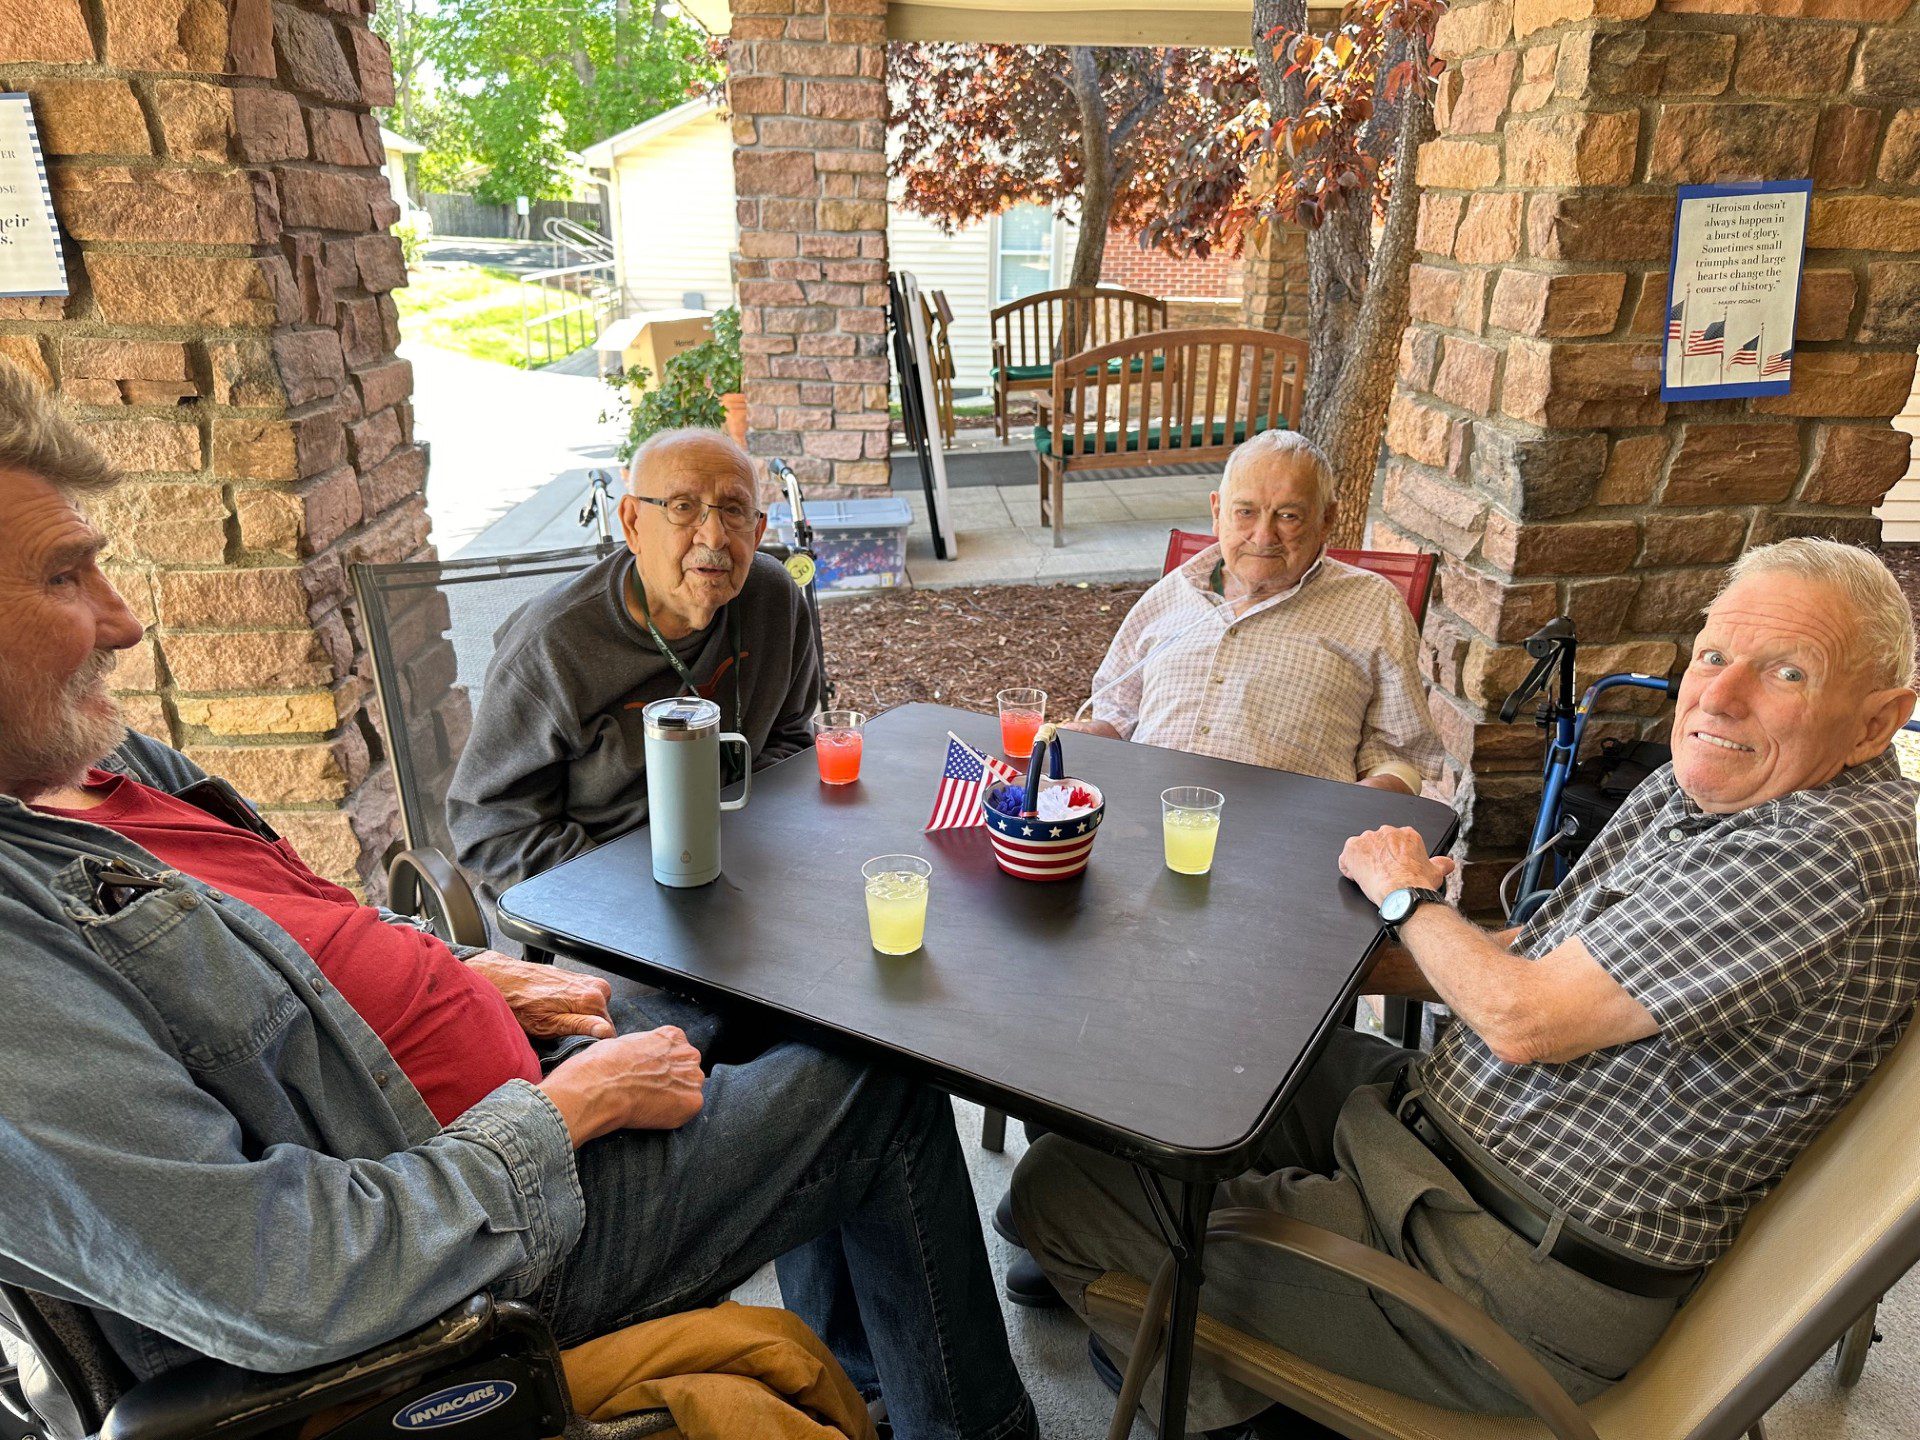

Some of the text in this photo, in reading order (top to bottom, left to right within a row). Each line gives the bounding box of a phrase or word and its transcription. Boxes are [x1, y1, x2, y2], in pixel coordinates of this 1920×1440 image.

[1704, 214, 1785, 228] always happen in
[1714, 230, 1740, 240] burst
[1742, 228, 1753, 238] of
[1753, 227, 1780, 240] glory.
[1701, 240, 1782, 253] Sometimes small
[1695, 254, 1786, 268] triumphs and large
[1697, 267, 1781, 281] hearts change the
[1695, 285, 1727, 294] course
[1729, 282, 1740, 292] of
[410, 1384, 496, 1426] INVACARE
